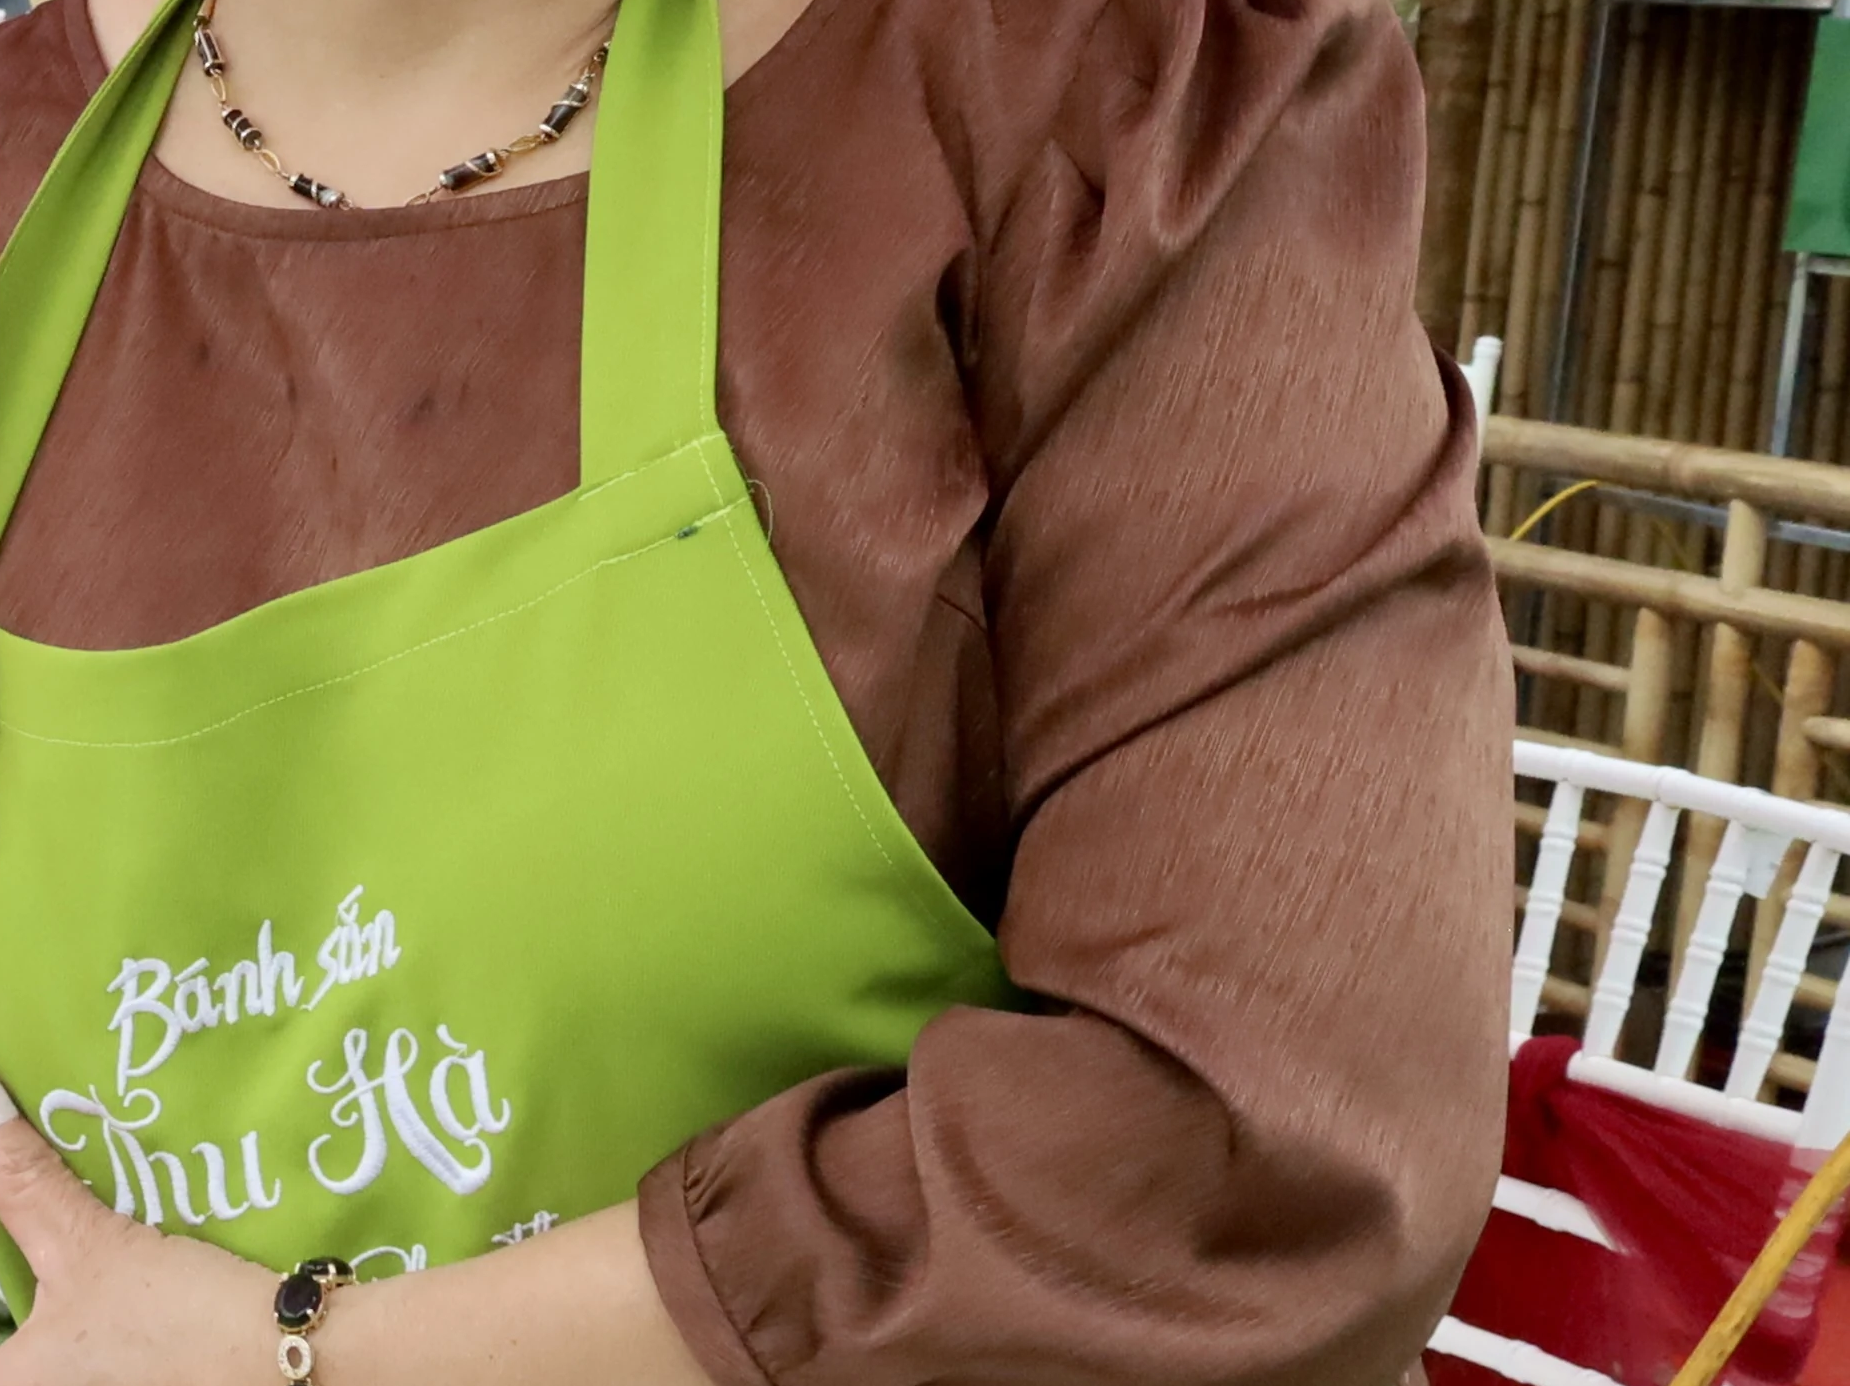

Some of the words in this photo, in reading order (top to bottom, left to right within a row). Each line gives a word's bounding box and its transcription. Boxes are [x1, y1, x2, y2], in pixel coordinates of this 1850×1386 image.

[106, 919, 304, 1097] Bánh
[300, 884, 402, 1011] sắn
[39, 1084, 282, 1226] Thu
[306, 1024, 511, 1195] Hà
